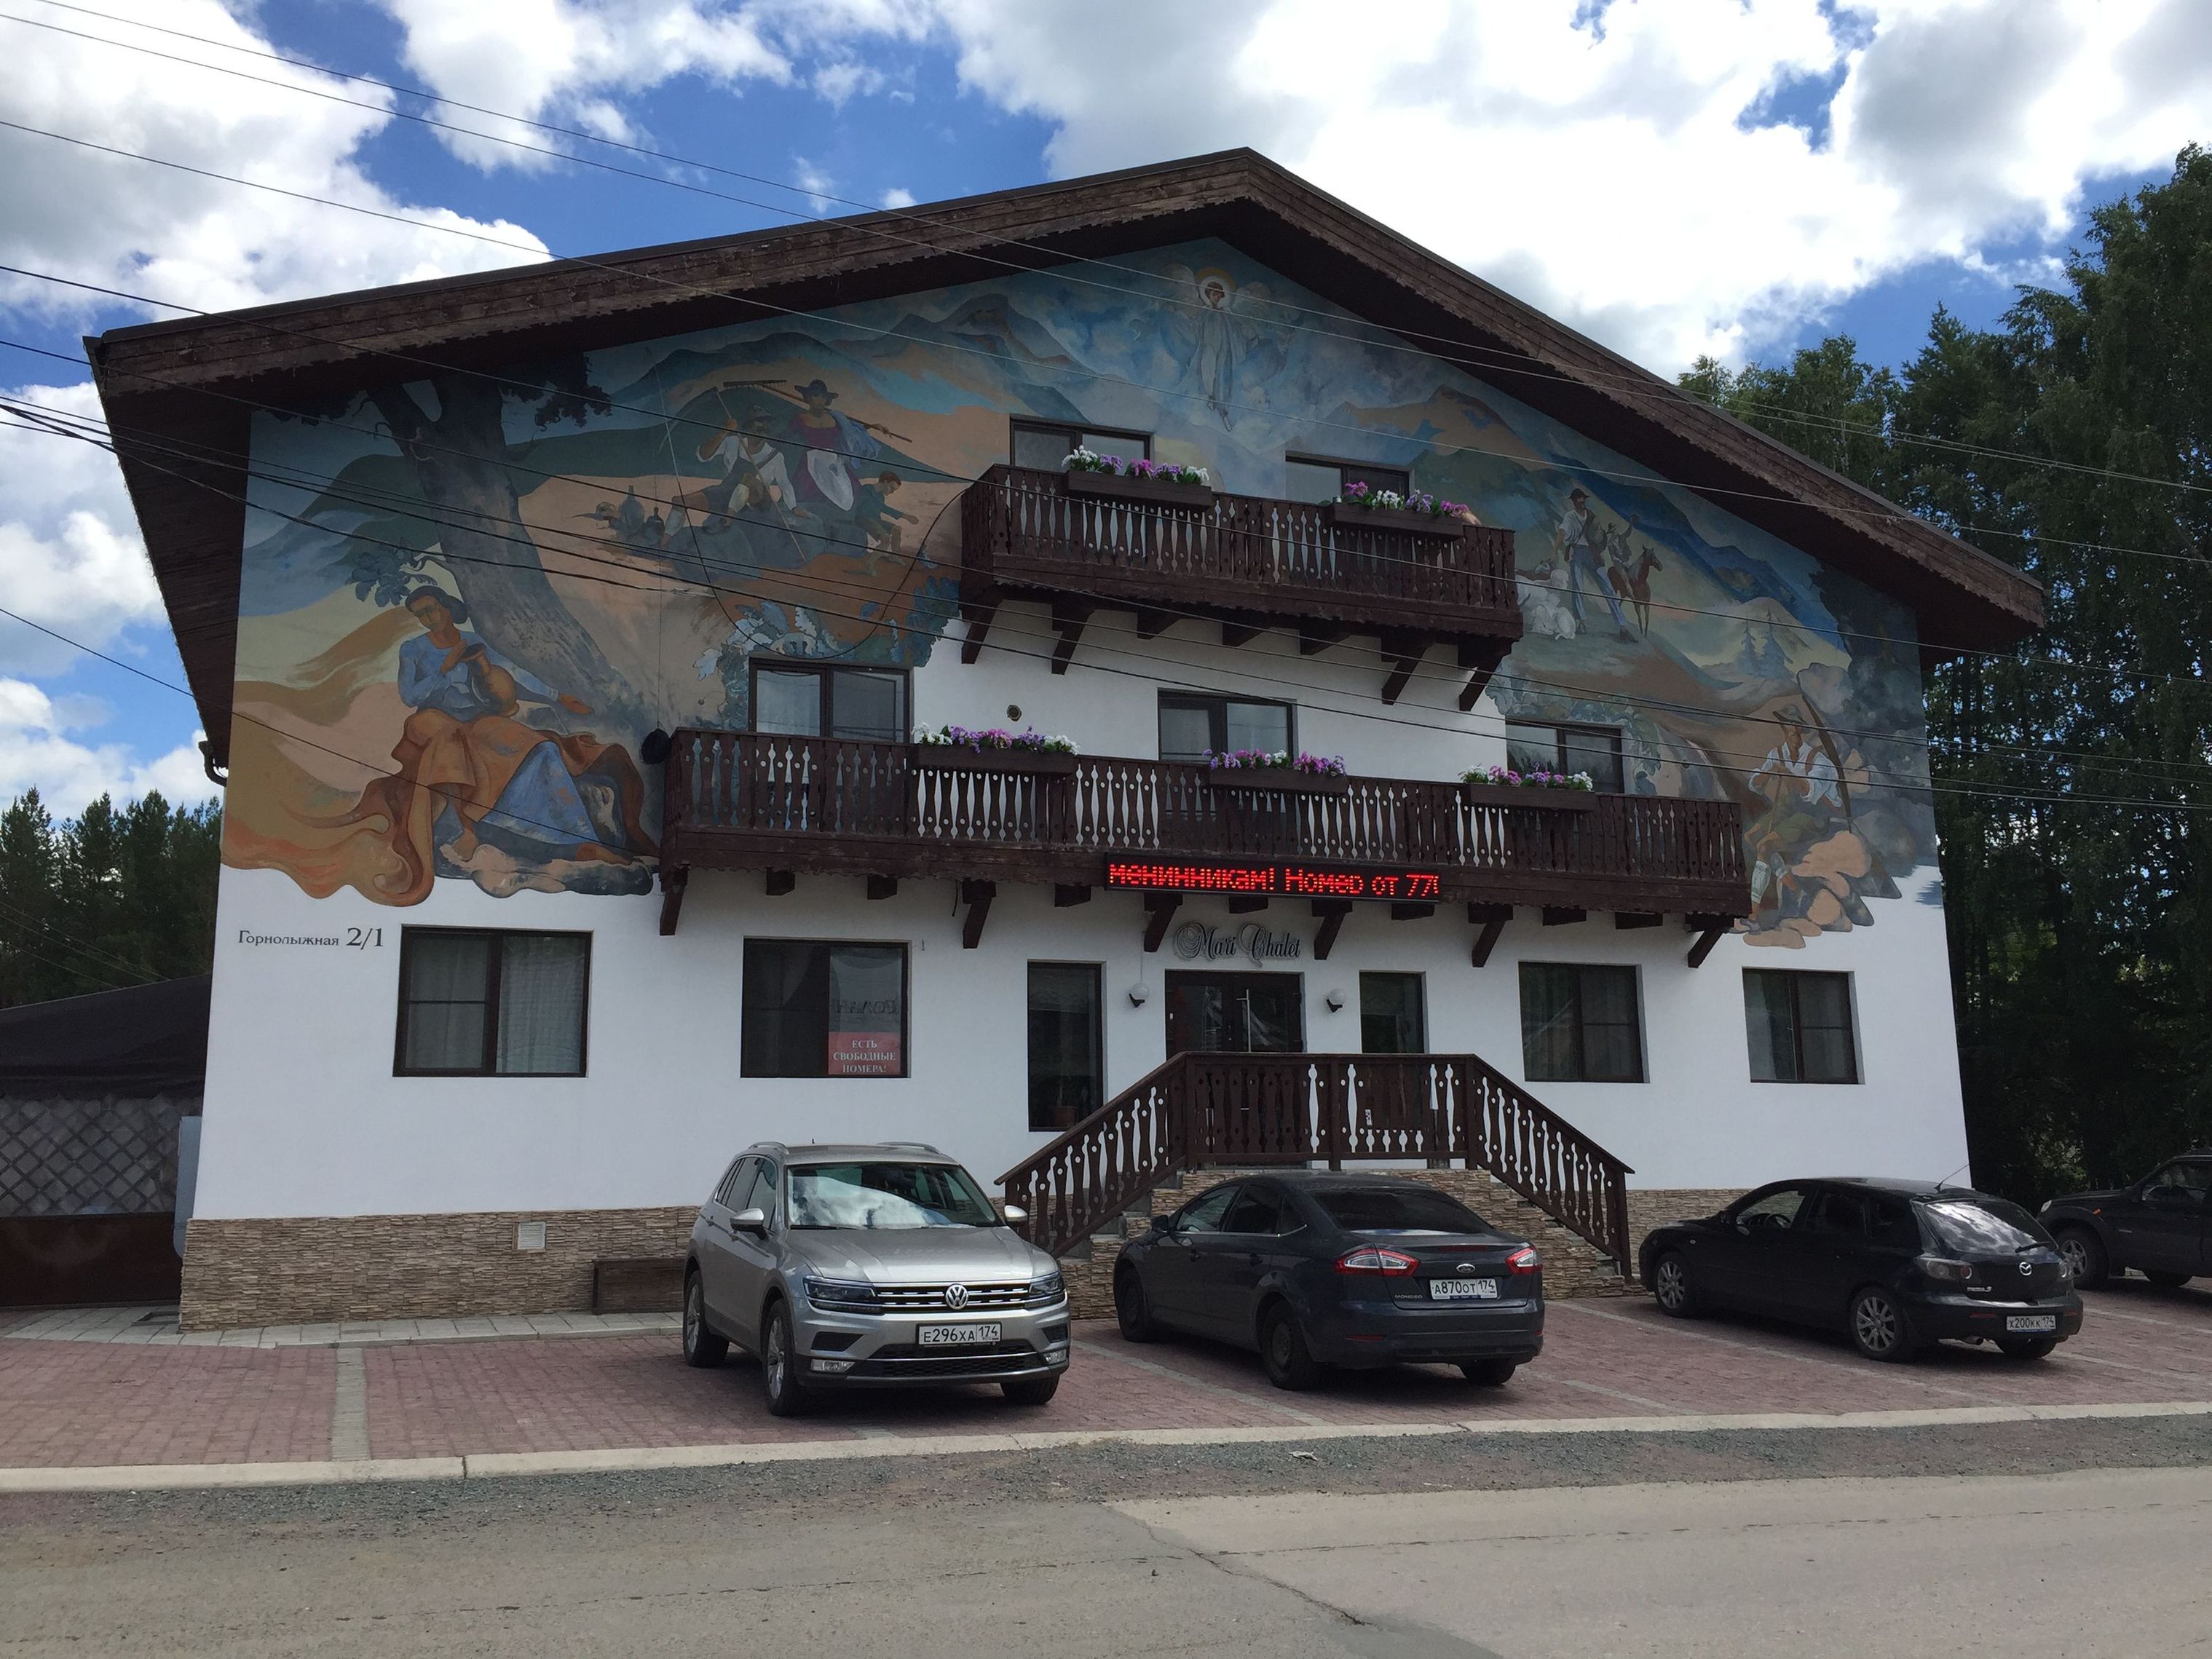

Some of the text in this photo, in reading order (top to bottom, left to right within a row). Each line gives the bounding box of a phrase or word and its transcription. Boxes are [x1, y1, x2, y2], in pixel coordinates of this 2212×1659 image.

[238, 927, 384, 950] Горнолыжная 2/1
[1176, 921, 1301, 968] Mari Chalet
[851, 1039, 878, 1049] ЕСТЬ
[832, 1051, 896, 1061] СВОБОДНЫЕ
[842, 1064, 887, 1074] НОМЕРА!
[1477, 1279, 1495, 1291] 174
[978, 1325, 999, 1338] 174
